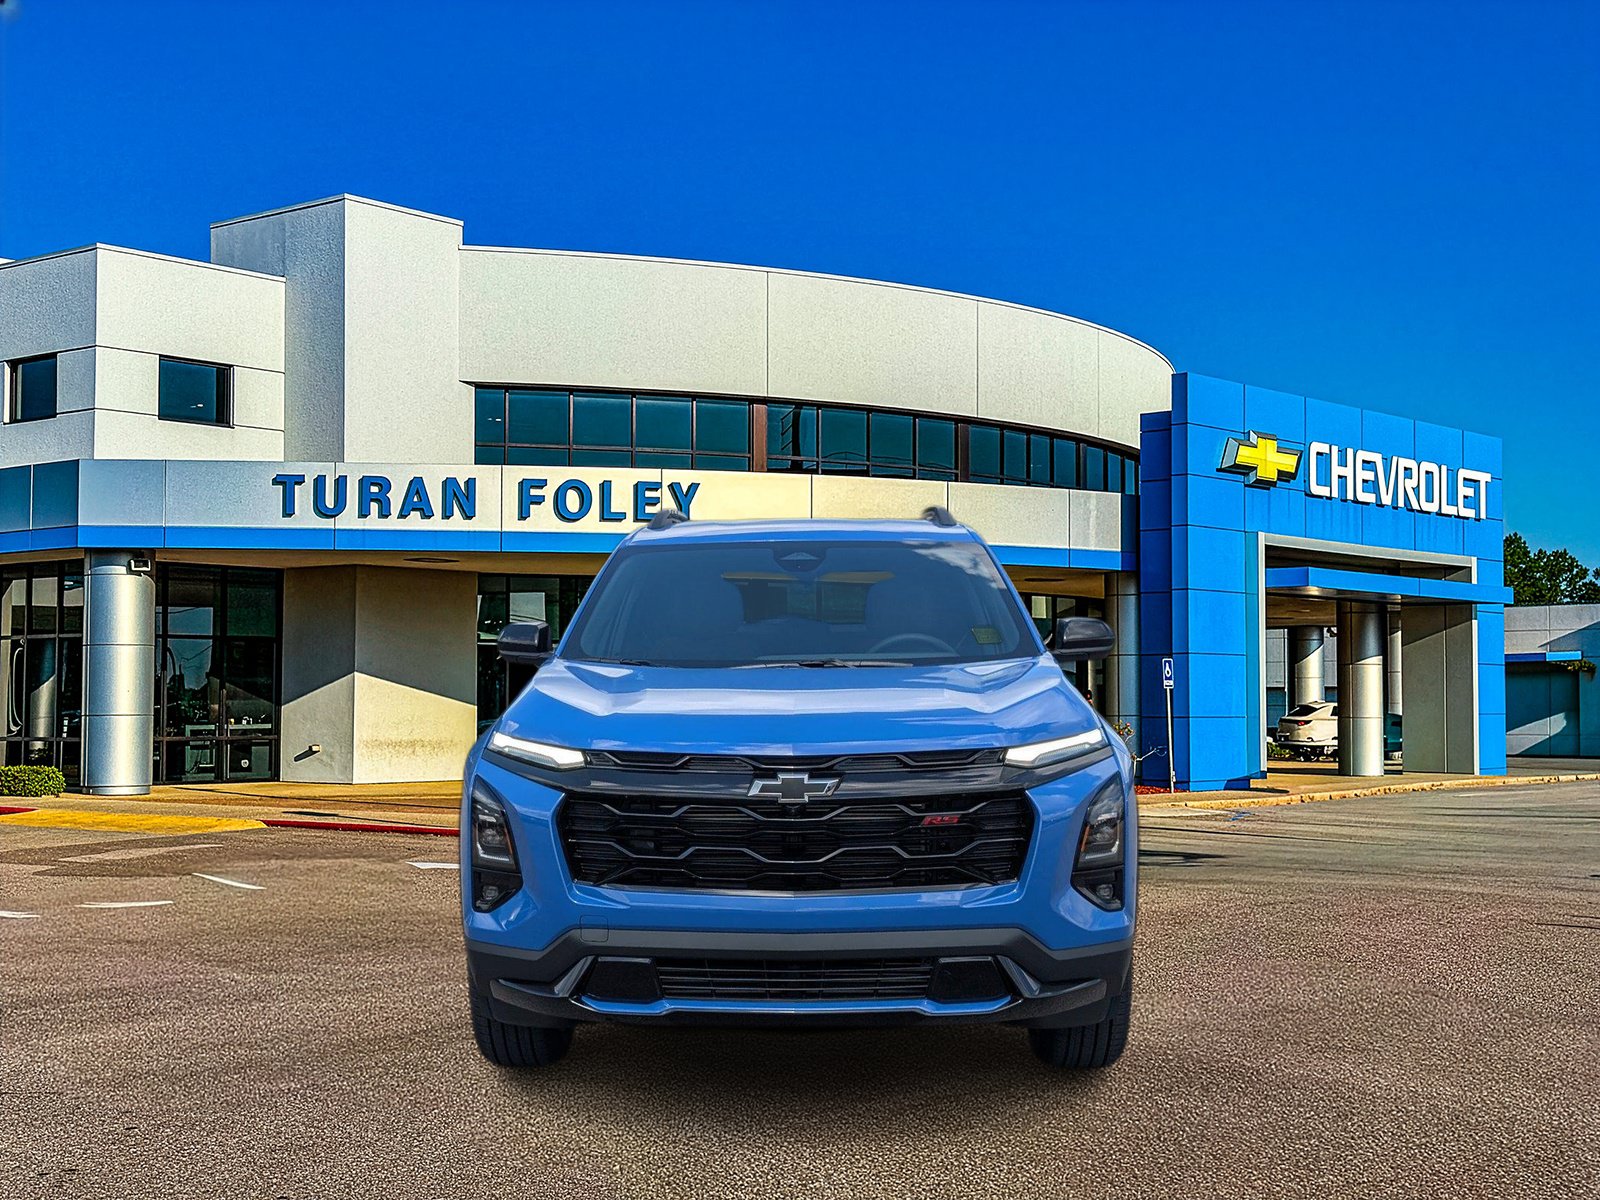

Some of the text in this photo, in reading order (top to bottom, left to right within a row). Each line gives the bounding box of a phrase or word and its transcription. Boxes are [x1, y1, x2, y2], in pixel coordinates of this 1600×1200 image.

[272, 473, 700, 522] TURAN FOLEY
[1308, 441, 1492, 519] CHEVROLET
[922, 816, 960, 826] RS
